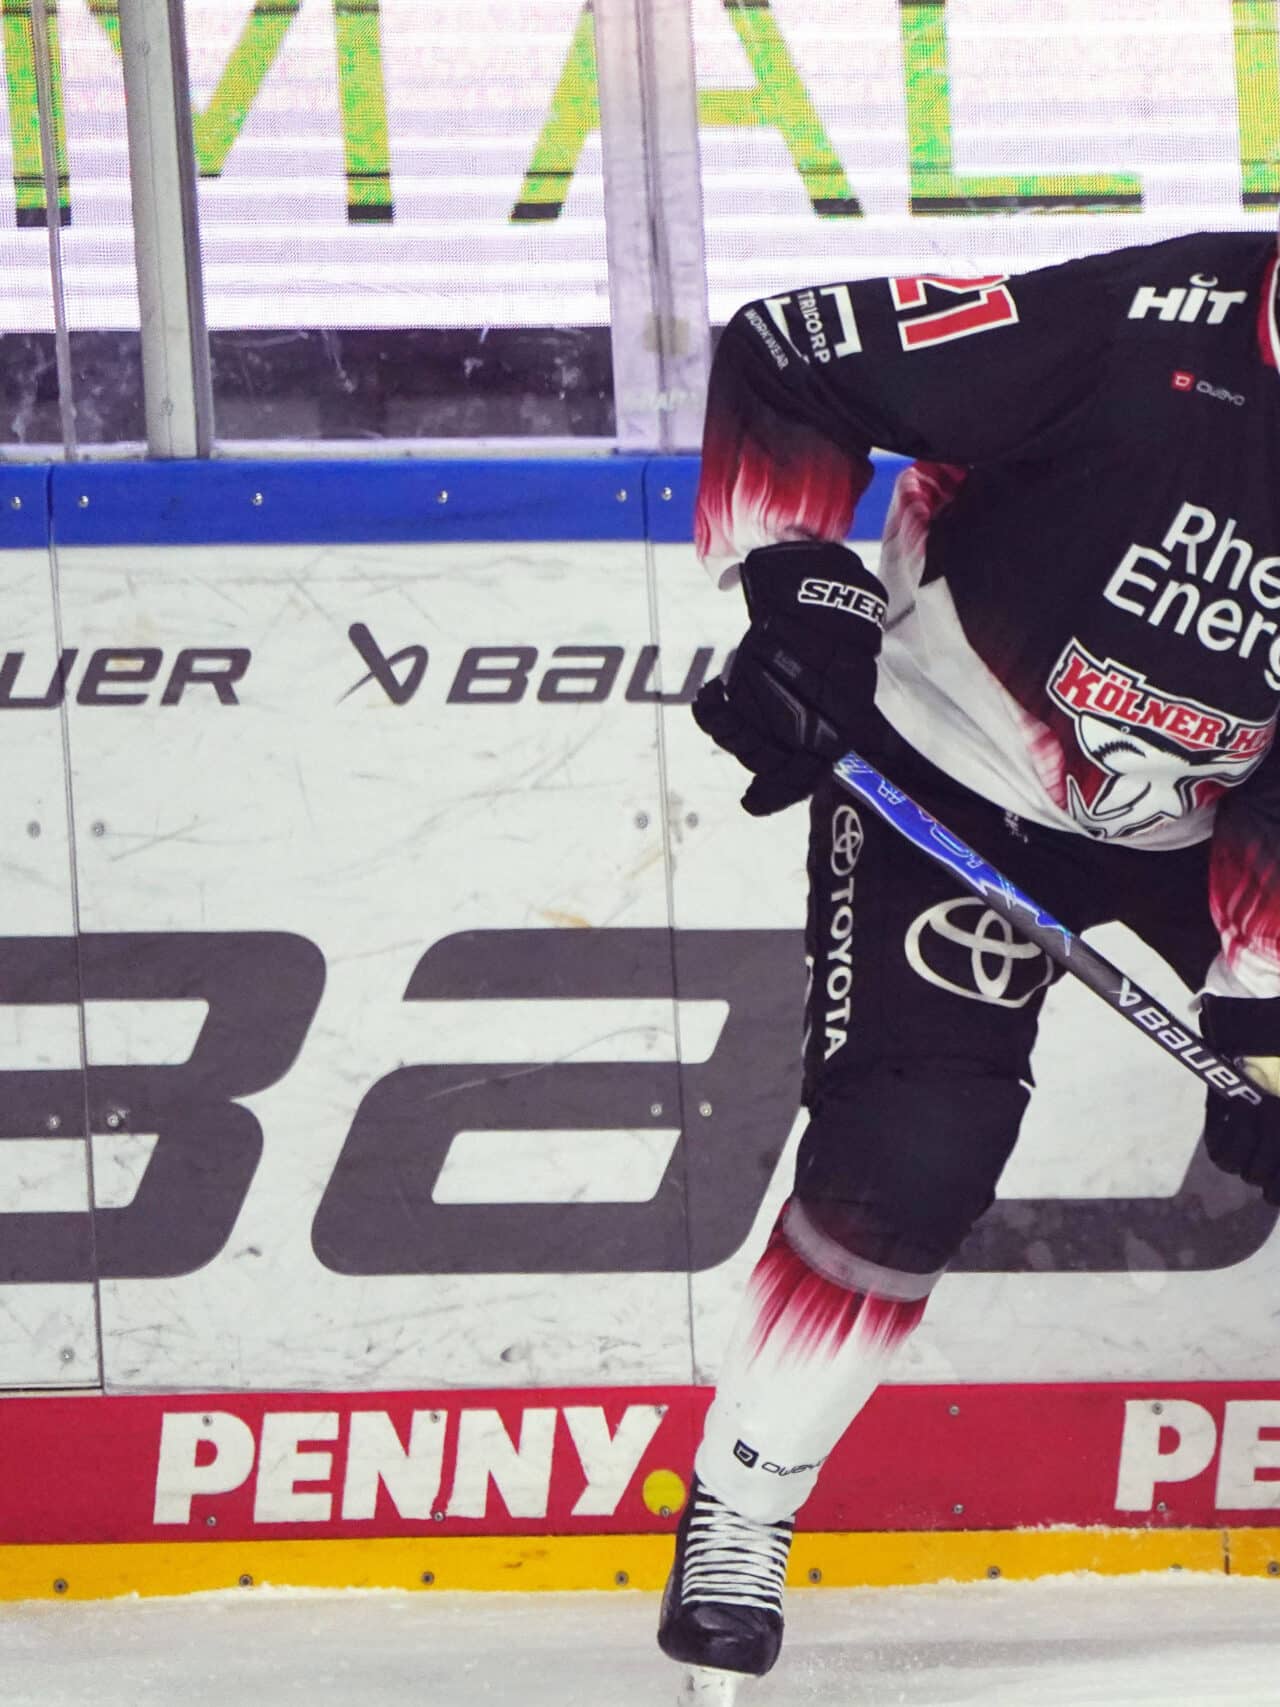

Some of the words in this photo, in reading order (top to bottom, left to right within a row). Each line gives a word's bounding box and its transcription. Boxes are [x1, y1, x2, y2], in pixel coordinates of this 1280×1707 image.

[744, 309, 789, 370] WORKWEAR
[798, 290, 831, 364] TRICORP
[1054, 655, 1225, 748] KÖLNER
[825, 877, 854, 1061] TOYOTA
